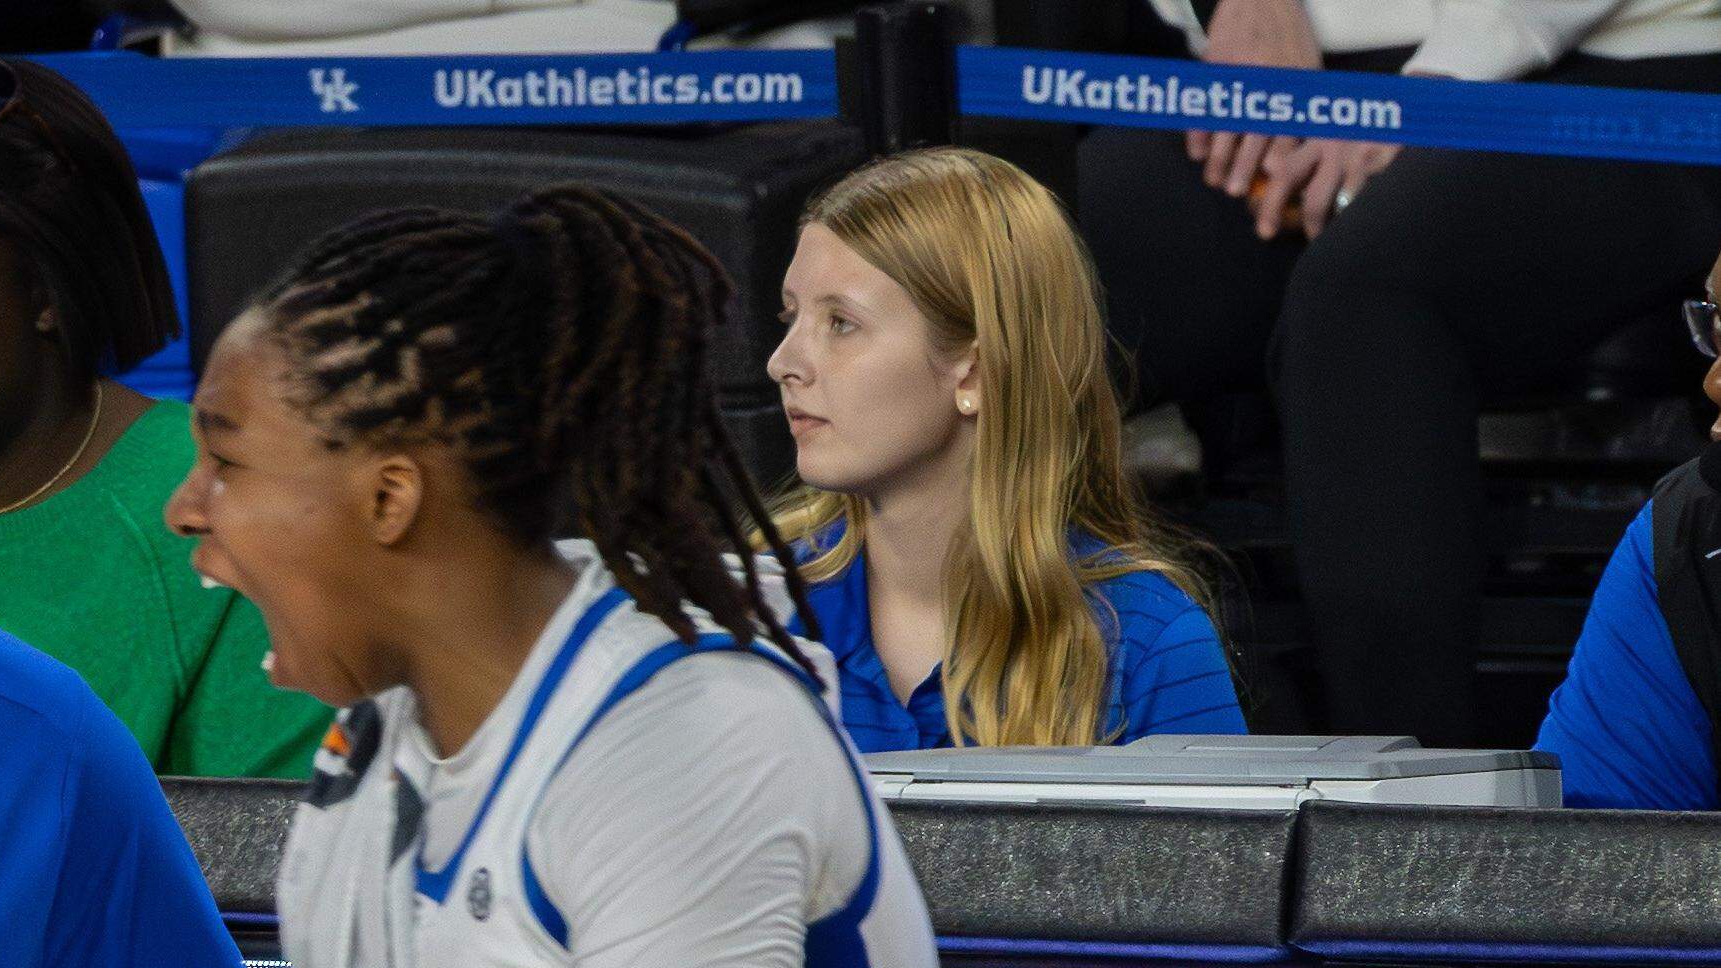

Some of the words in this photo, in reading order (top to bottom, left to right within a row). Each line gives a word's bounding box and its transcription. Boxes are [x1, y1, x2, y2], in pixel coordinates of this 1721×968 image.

[309, 68, 360, 112] UK
[433, 68, 804, 107] UKathletics.com
[1021, 65, 1402, 129] UKathletics.com
